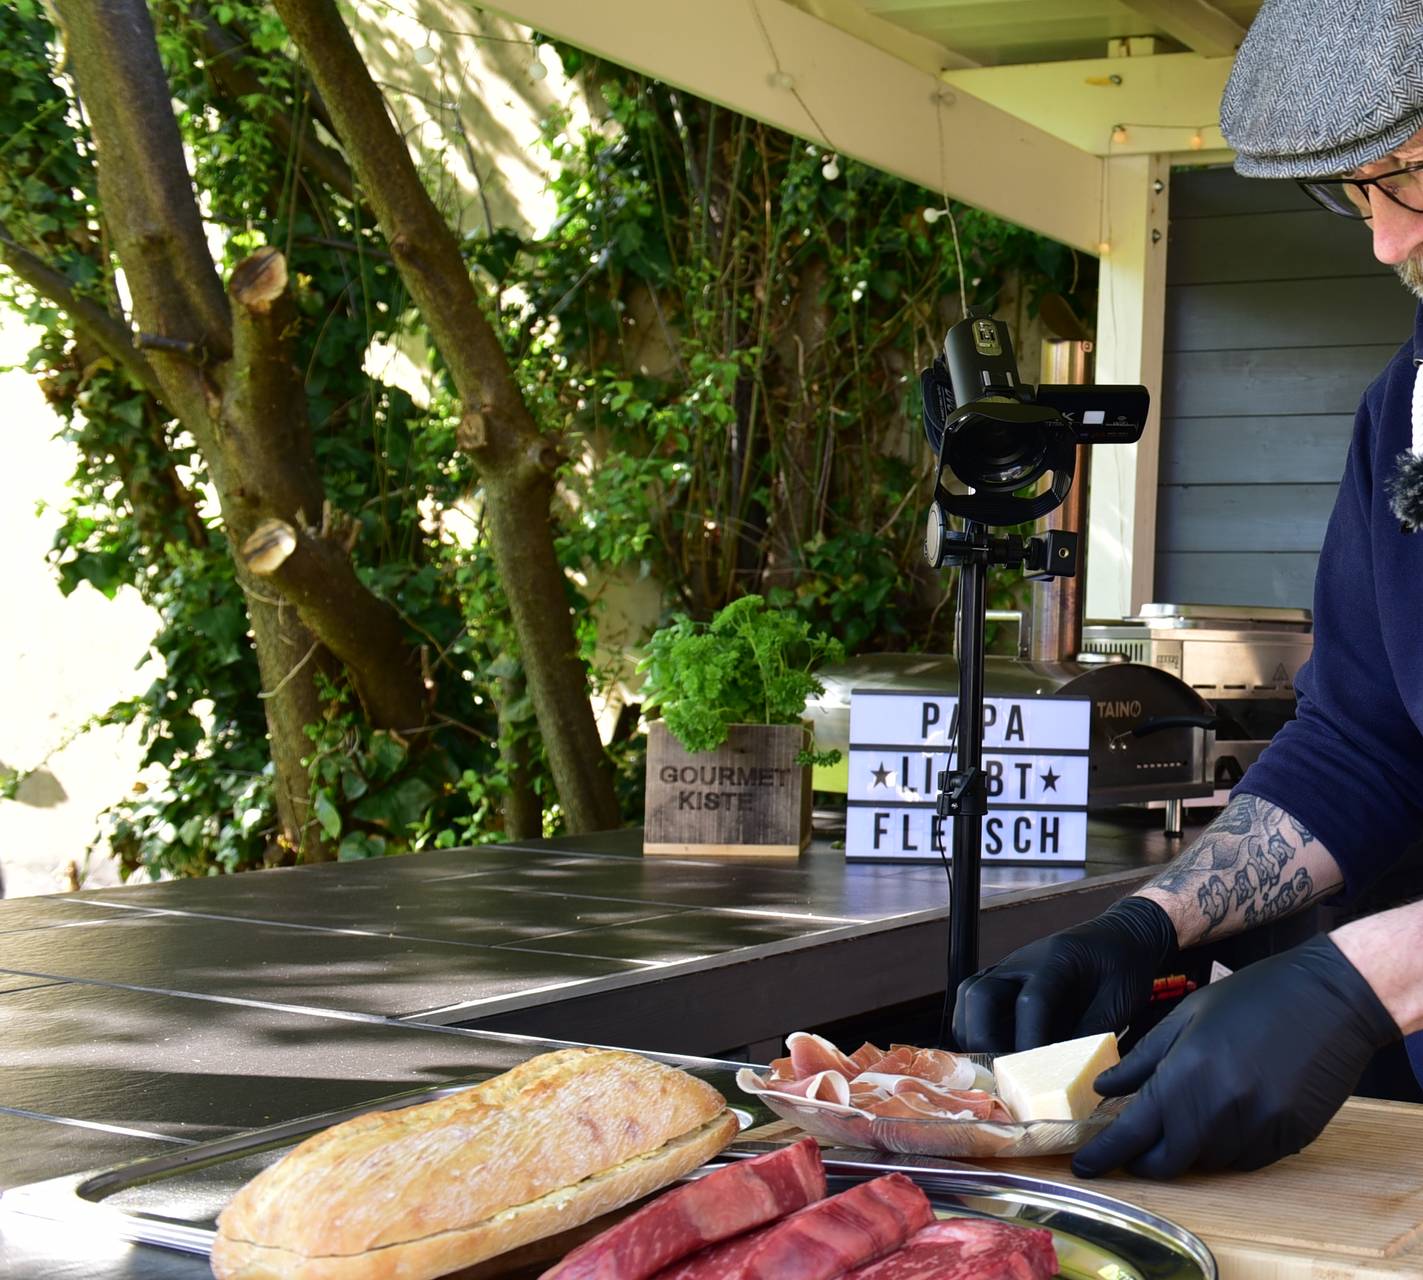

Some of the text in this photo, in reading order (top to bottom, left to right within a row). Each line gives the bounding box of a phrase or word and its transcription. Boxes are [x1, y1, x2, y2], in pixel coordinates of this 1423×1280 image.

[921, 702, 1025, 741] PPA
[659, 765, 792, 787] GOURMET
[902, 755, 1033, 799] LIBT
[678, 790, 753, 811] KISTE
[873, 812, 1060, 855] FLESCH
